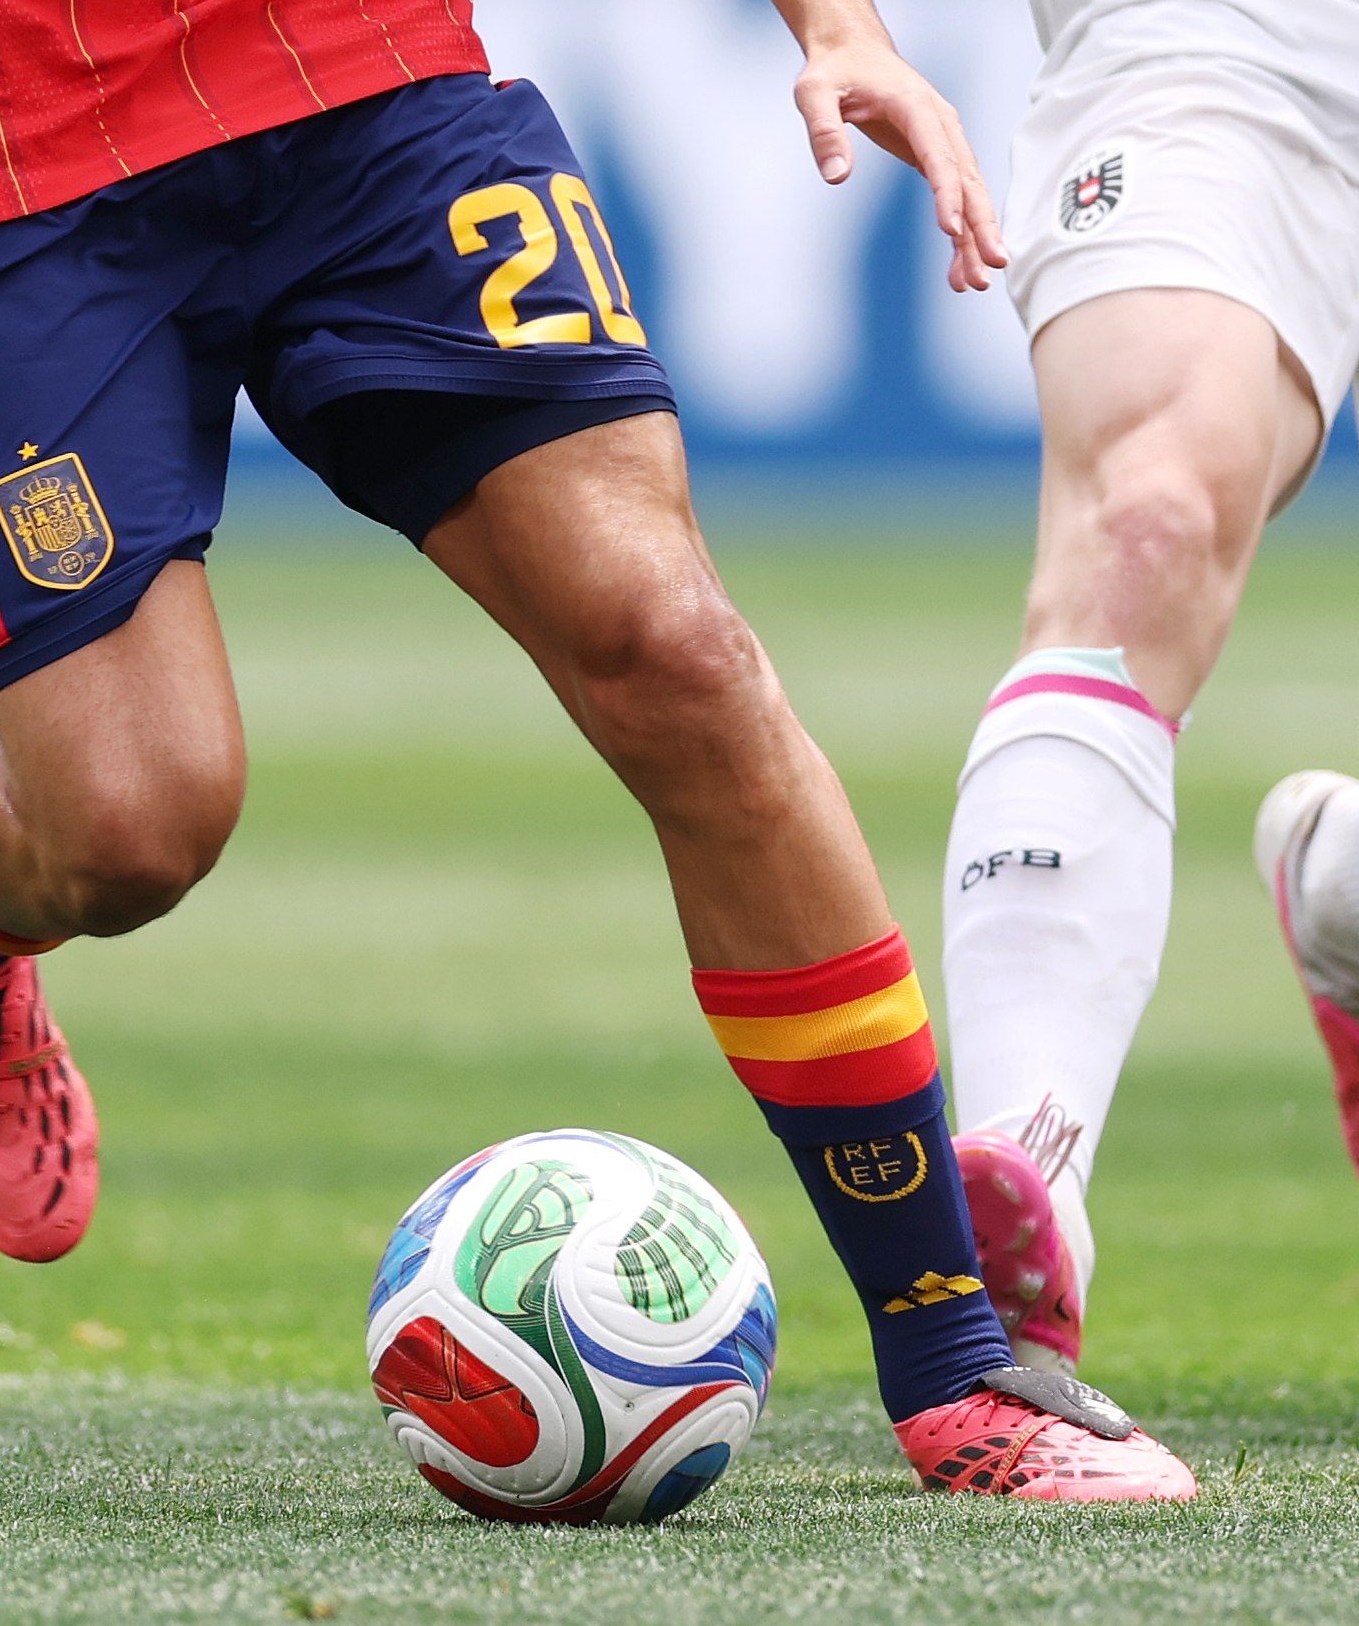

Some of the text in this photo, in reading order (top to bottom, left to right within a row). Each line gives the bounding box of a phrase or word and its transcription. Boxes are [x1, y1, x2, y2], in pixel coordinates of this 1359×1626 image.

[448, 172, 648, 349] 20
[842, 1138, 892, 1162] RF
[850, 1160, 902, 1186] EF
